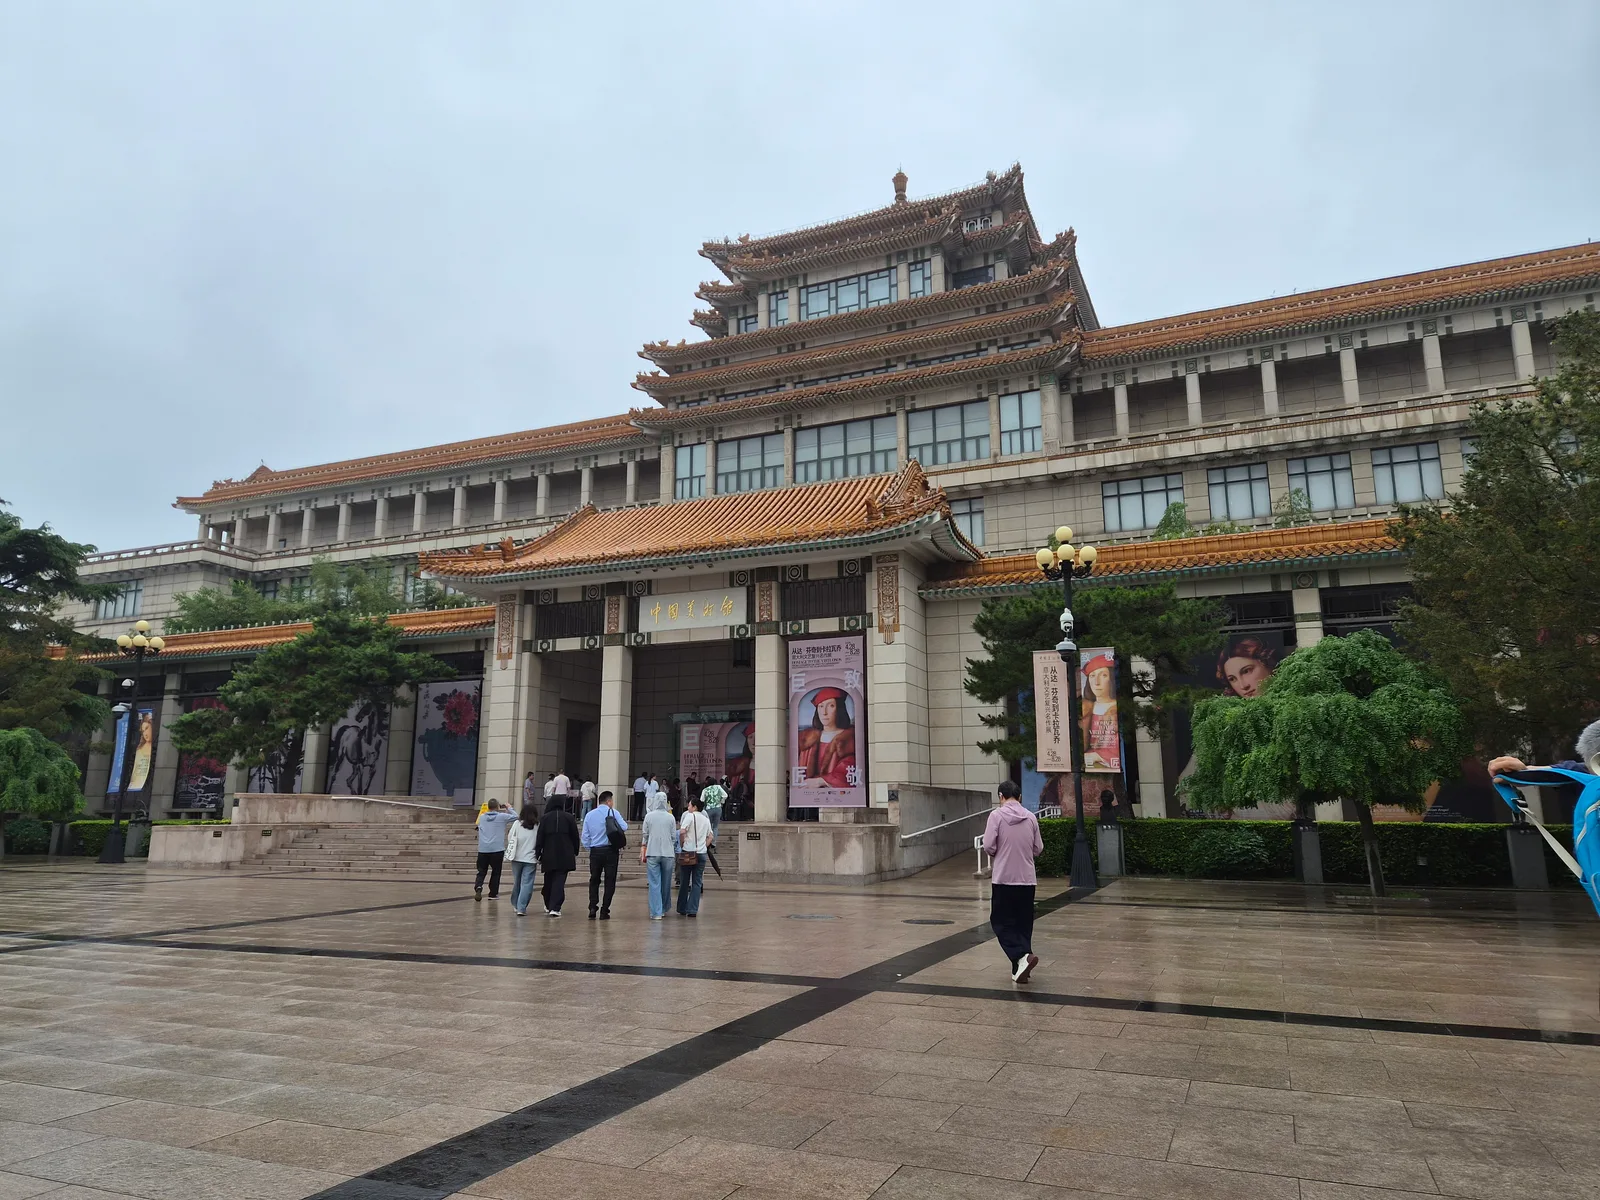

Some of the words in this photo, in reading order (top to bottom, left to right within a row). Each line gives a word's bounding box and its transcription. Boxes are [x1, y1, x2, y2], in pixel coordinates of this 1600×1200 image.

[792, 673, 806, 692] 巨
[844, 669, 861, 689] 致
[683, 727, 700, 750] 巨
[792, 766, 808, 786] 匠
[846, 765, 863, 786] 敬
